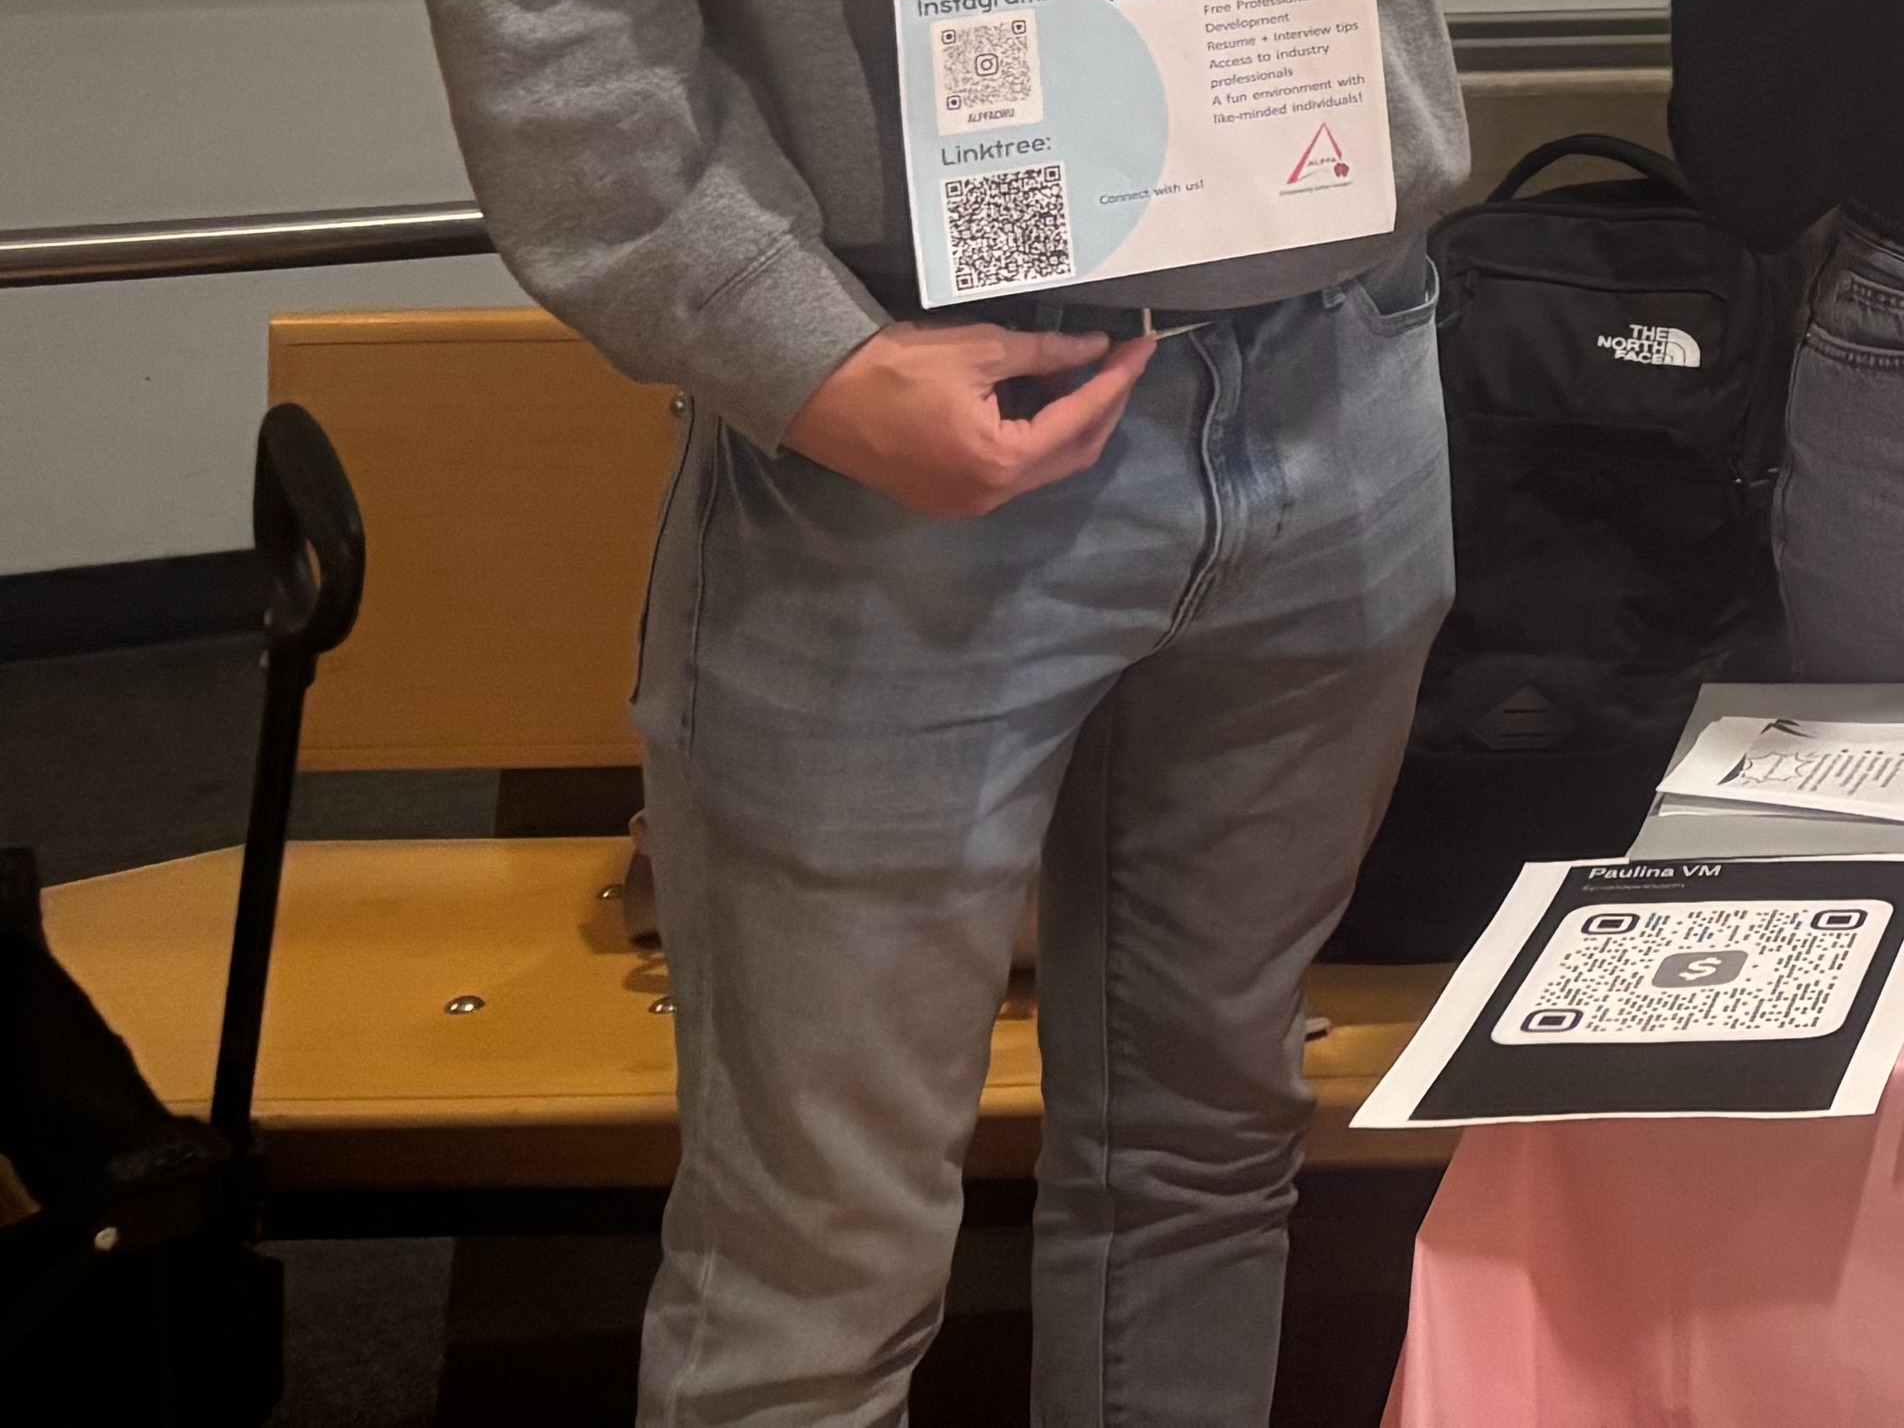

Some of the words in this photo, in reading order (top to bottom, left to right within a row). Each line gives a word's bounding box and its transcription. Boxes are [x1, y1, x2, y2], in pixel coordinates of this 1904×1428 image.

[1204, 4, 1231, 15] Free
[1205, 13, 1290, 33] Development
[1207, 37, 1256, 52] Resume
[1274, 25, 1331, 42] Interview
[1335, 21, 1359, 35] tips
[1209, 54, 1252, 69] Access
[1257, 52, 1271, 62] to
[1276, 44, 1330, 61] industry
[1210, 67, 1294, 90] professionals
[1212, 96, 1222, 106] A
[1226, 93, 1247, 104] fun
[1252, 79, 1332, 101] environment
[1337, 74, 1365, 87] with
[941, 137, 1052, 166] Linktree:
[1629, 324, 1669, 342] THE
[1597, 335, 1666, 354] NORTH
[1614, 350, 1665, 365] FACE
[1588, 865, 1675, 880] Paulina
[1683, 864, 1722, 878] VM
